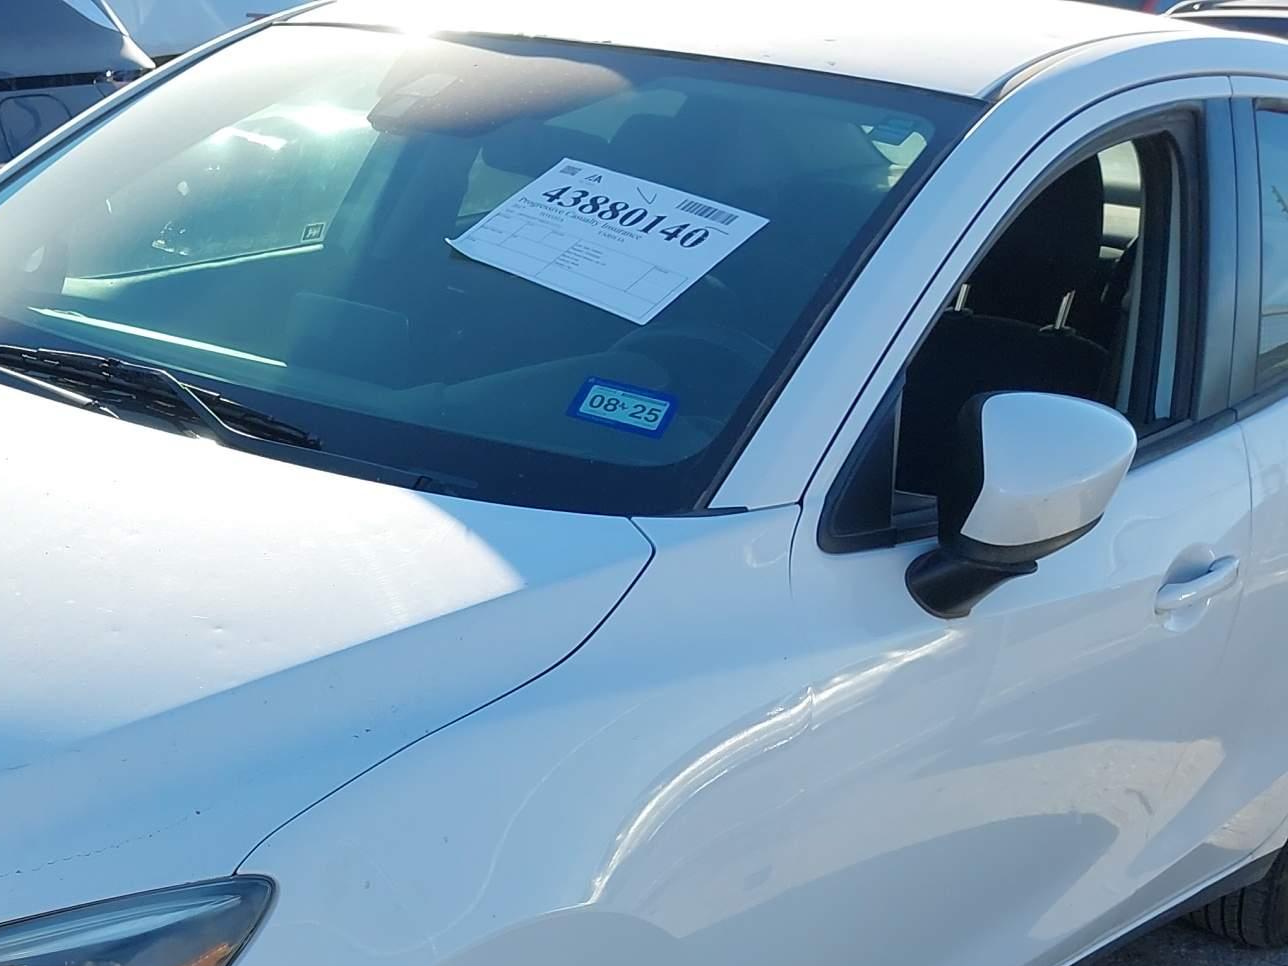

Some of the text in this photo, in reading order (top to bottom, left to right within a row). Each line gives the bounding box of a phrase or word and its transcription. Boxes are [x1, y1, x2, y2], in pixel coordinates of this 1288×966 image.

[541, 185, 710, 248] 43880140
[600, 222, 643, 240] Insurance
[589, 394, 662, 423] 08 25
